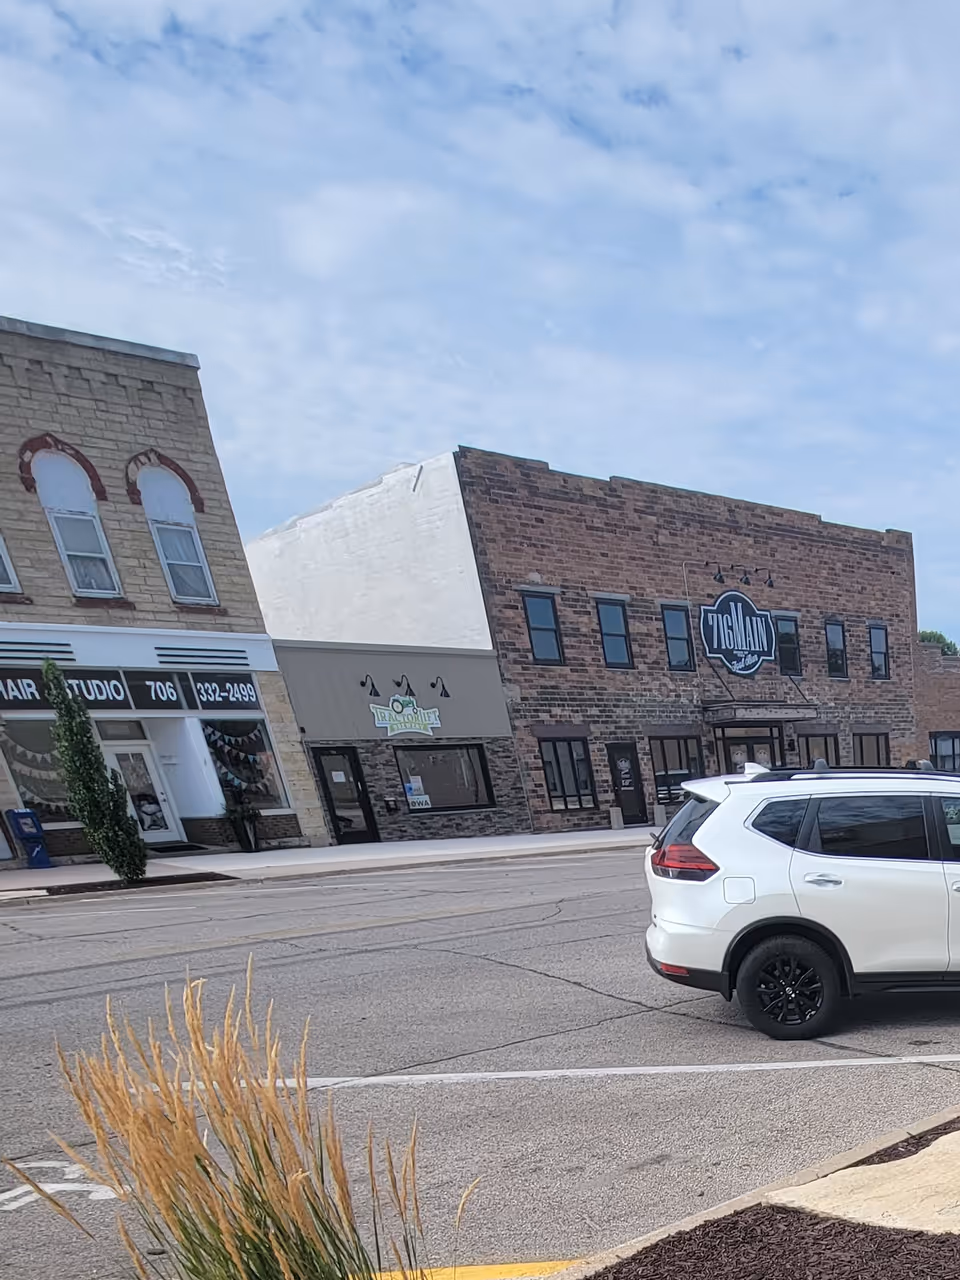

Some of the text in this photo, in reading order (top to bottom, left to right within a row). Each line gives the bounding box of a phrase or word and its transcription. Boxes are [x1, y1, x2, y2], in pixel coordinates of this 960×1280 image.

[63, 679, 125, 701] TUDIO
[145, 680, 178, 701] 706
[196, 682, 257, 702] 332-2499
